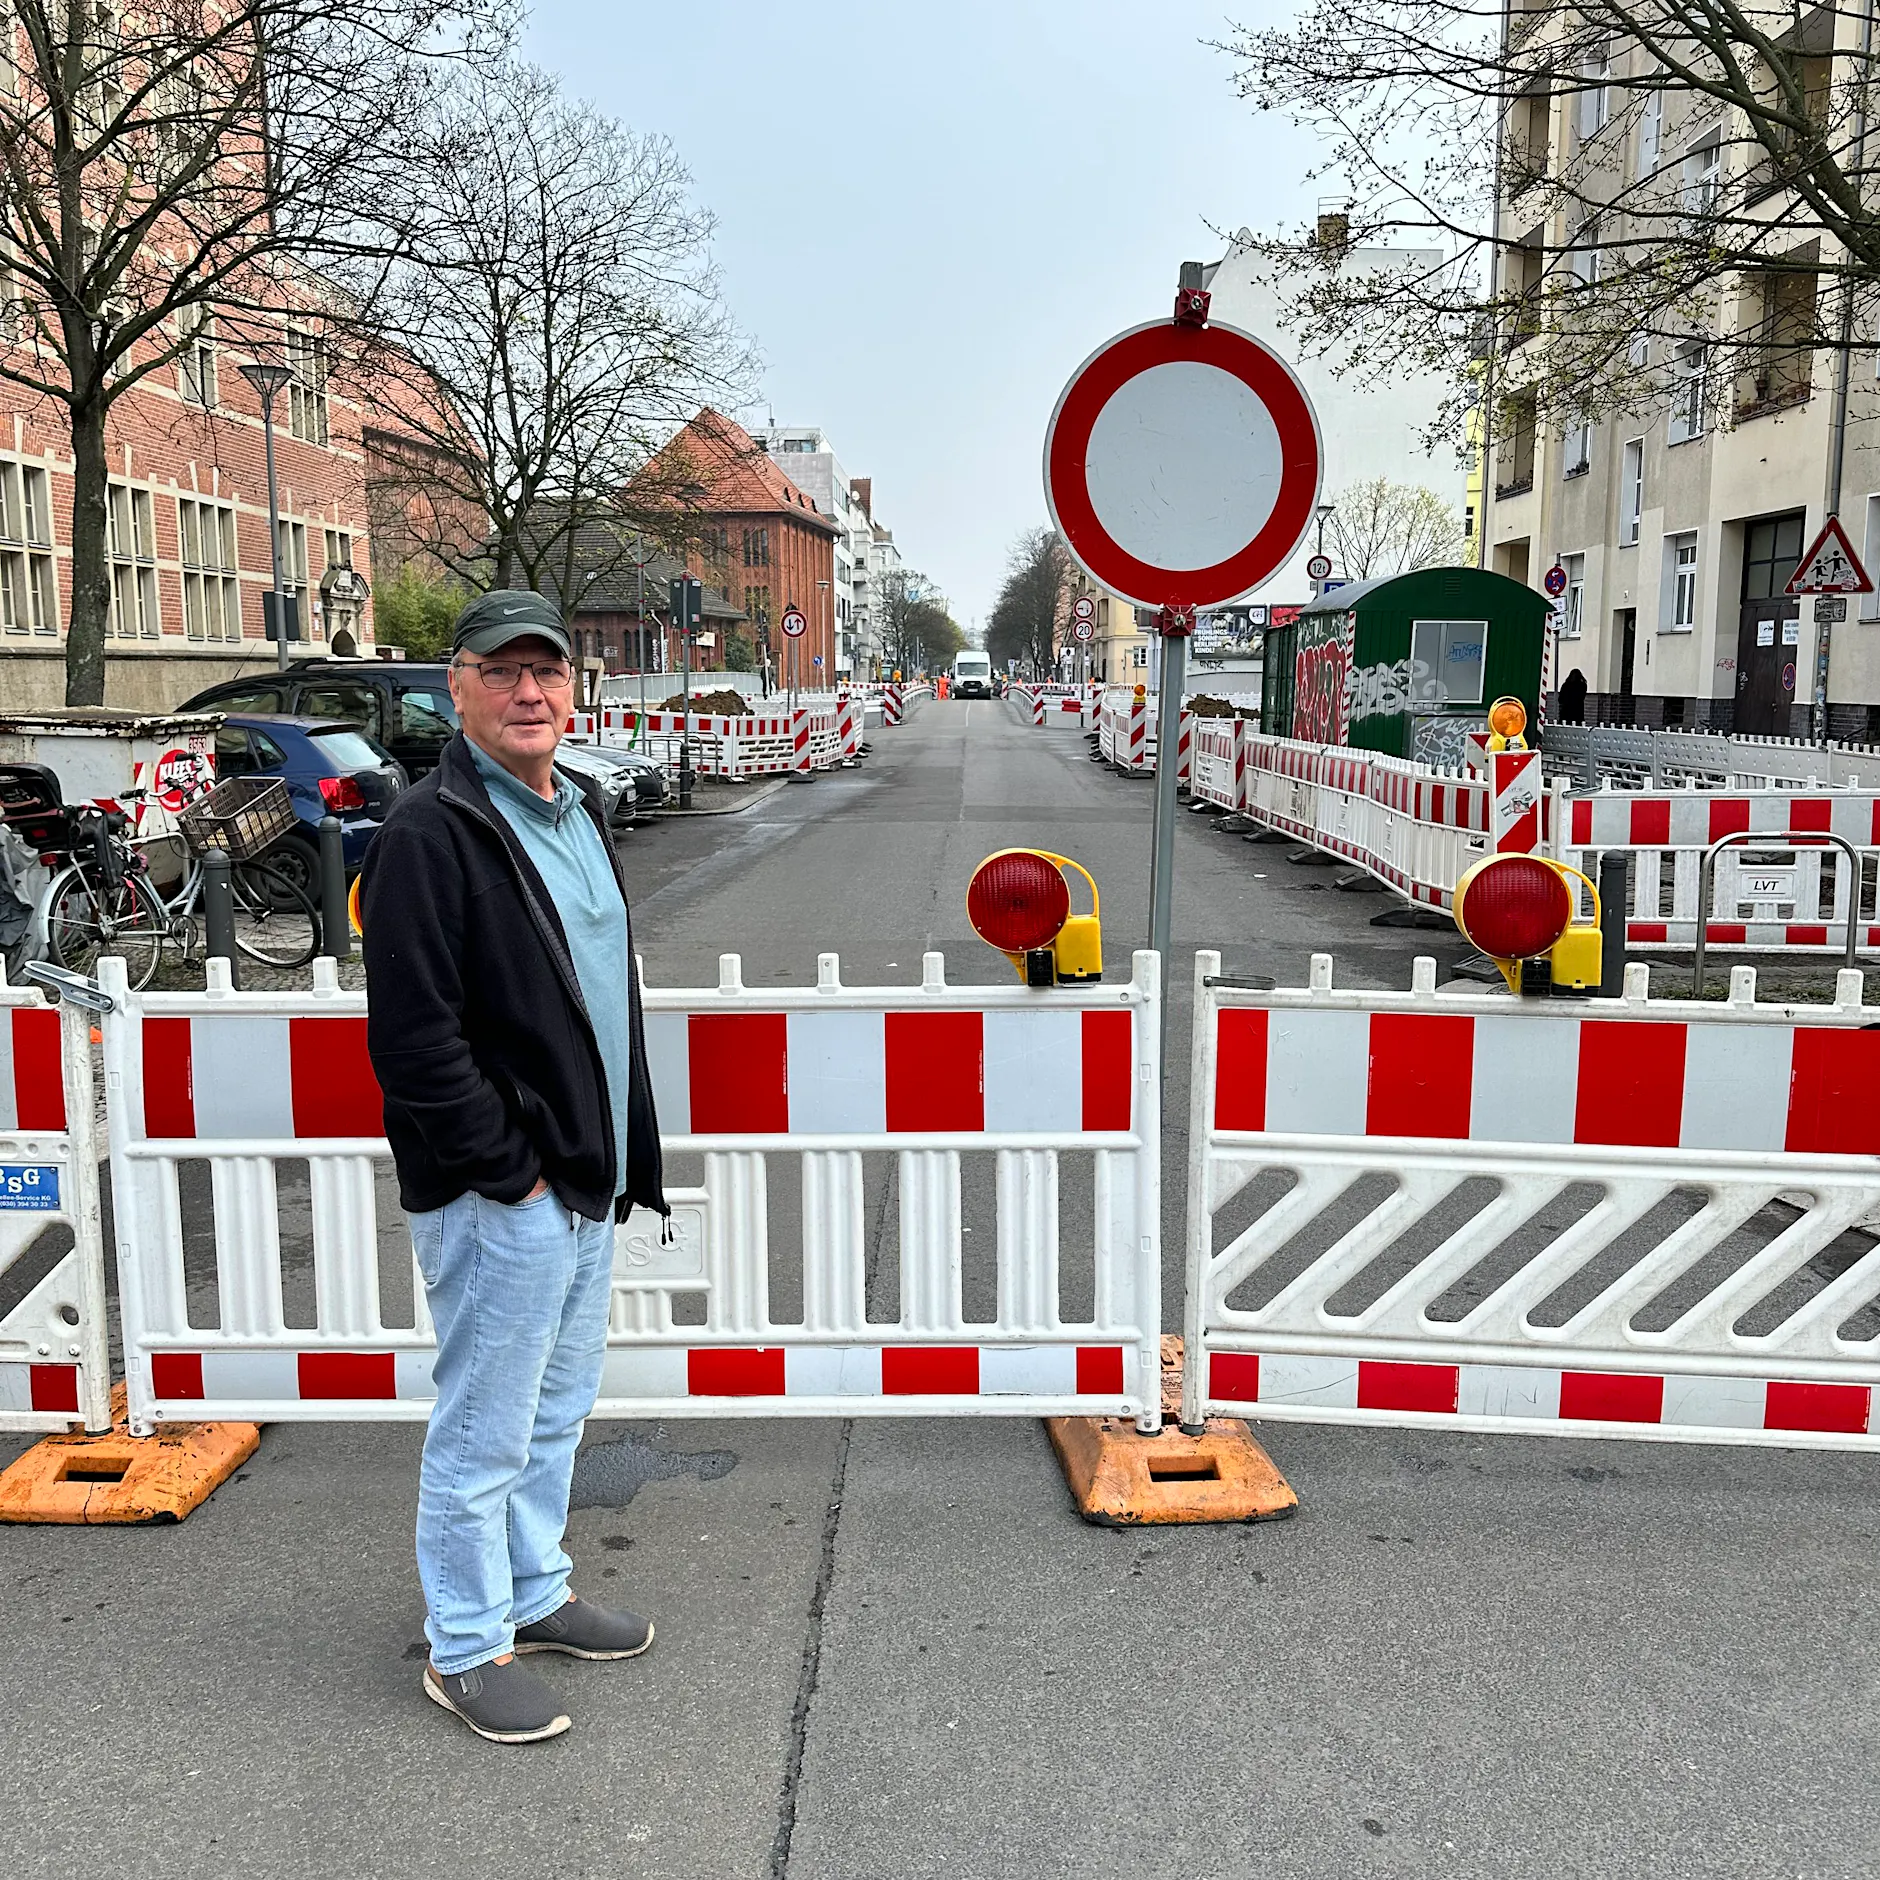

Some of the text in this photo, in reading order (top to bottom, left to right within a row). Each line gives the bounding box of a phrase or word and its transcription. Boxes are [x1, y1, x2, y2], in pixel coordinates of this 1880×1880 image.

[1312, 563, 1326, 574] 12t
[1078, 625, 1090, 636] 20
[1754, 880, 1779, 891] LVT
